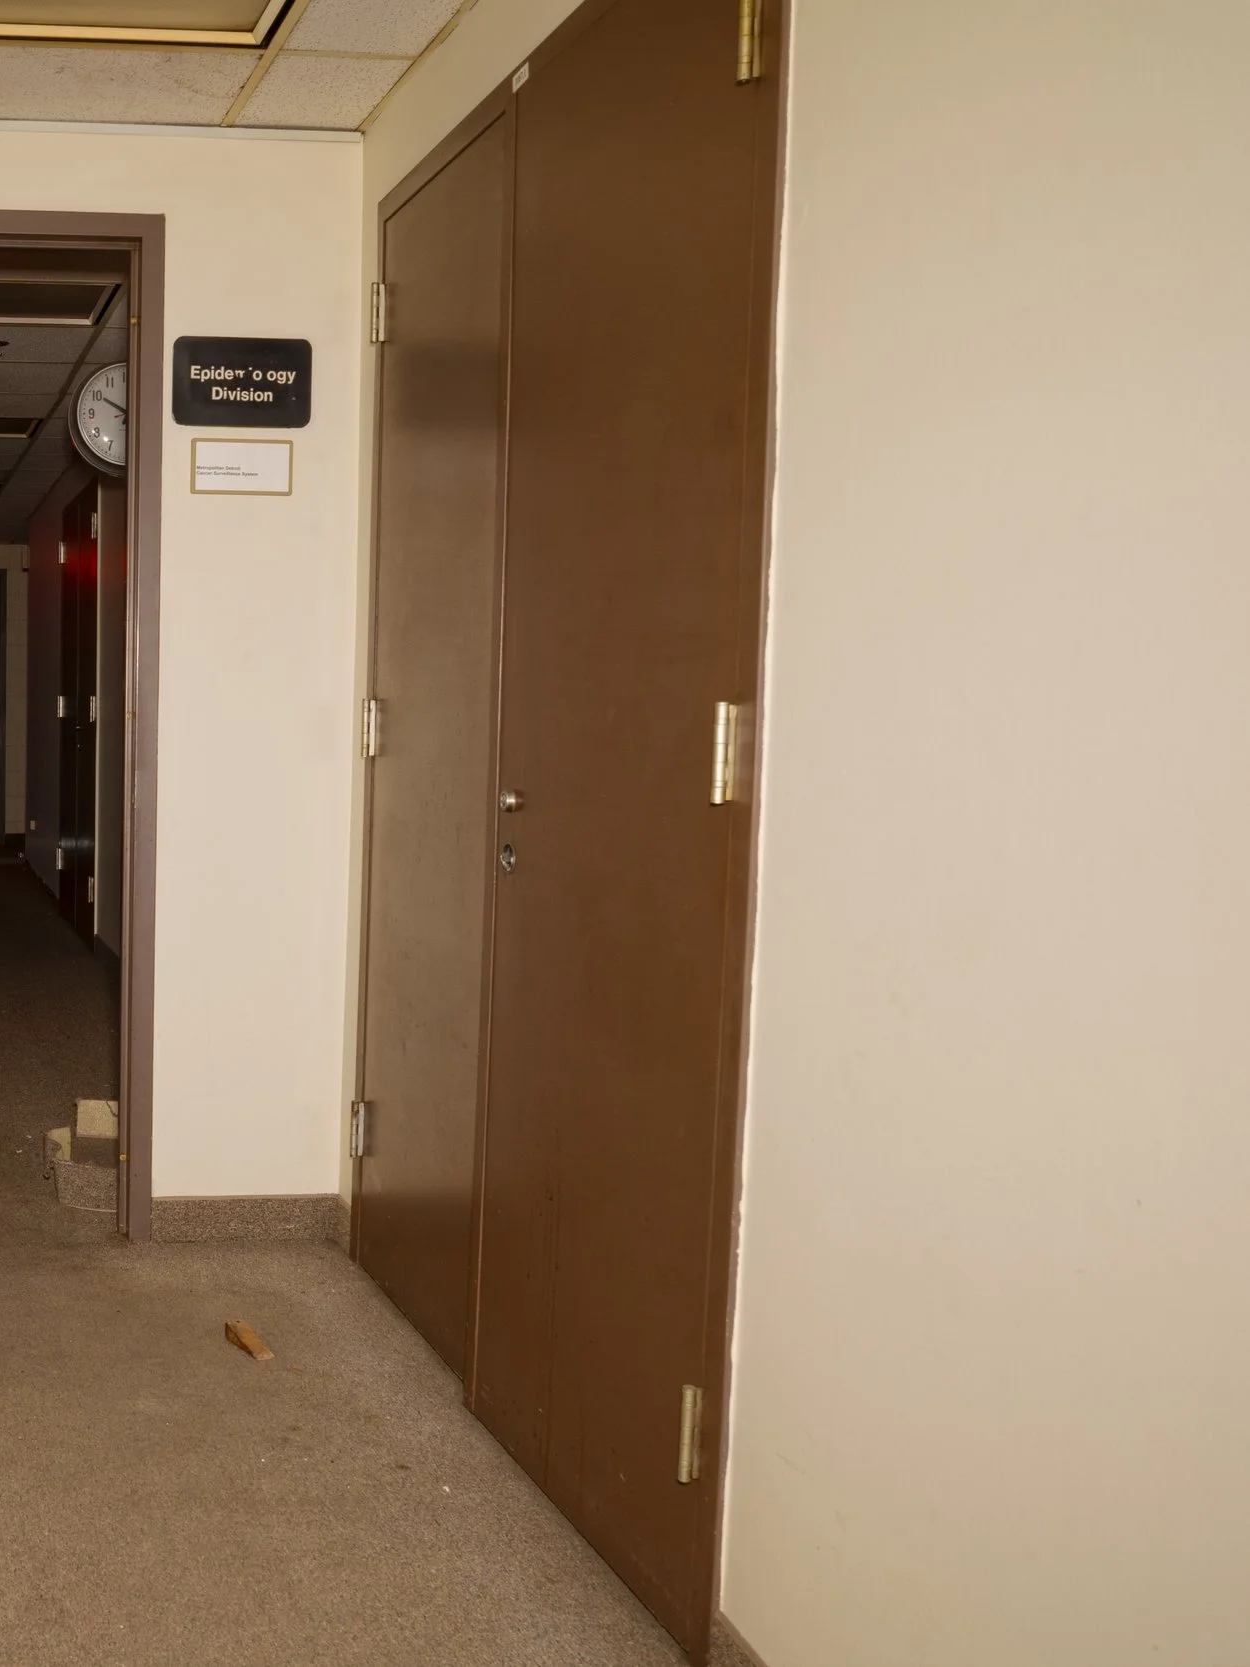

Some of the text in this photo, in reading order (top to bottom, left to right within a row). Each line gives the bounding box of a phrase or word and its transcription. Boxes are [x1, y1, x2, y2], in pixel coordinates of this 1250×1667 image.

[190, 365, 296, 384] Epideoogy
[106, 376, 114, 388] 11
[92, 390, 102, 402] 10
[211, 386, 273, 402] Division
[88, 408, 95, 420] 9
[107, 440, 114, 451] 7
